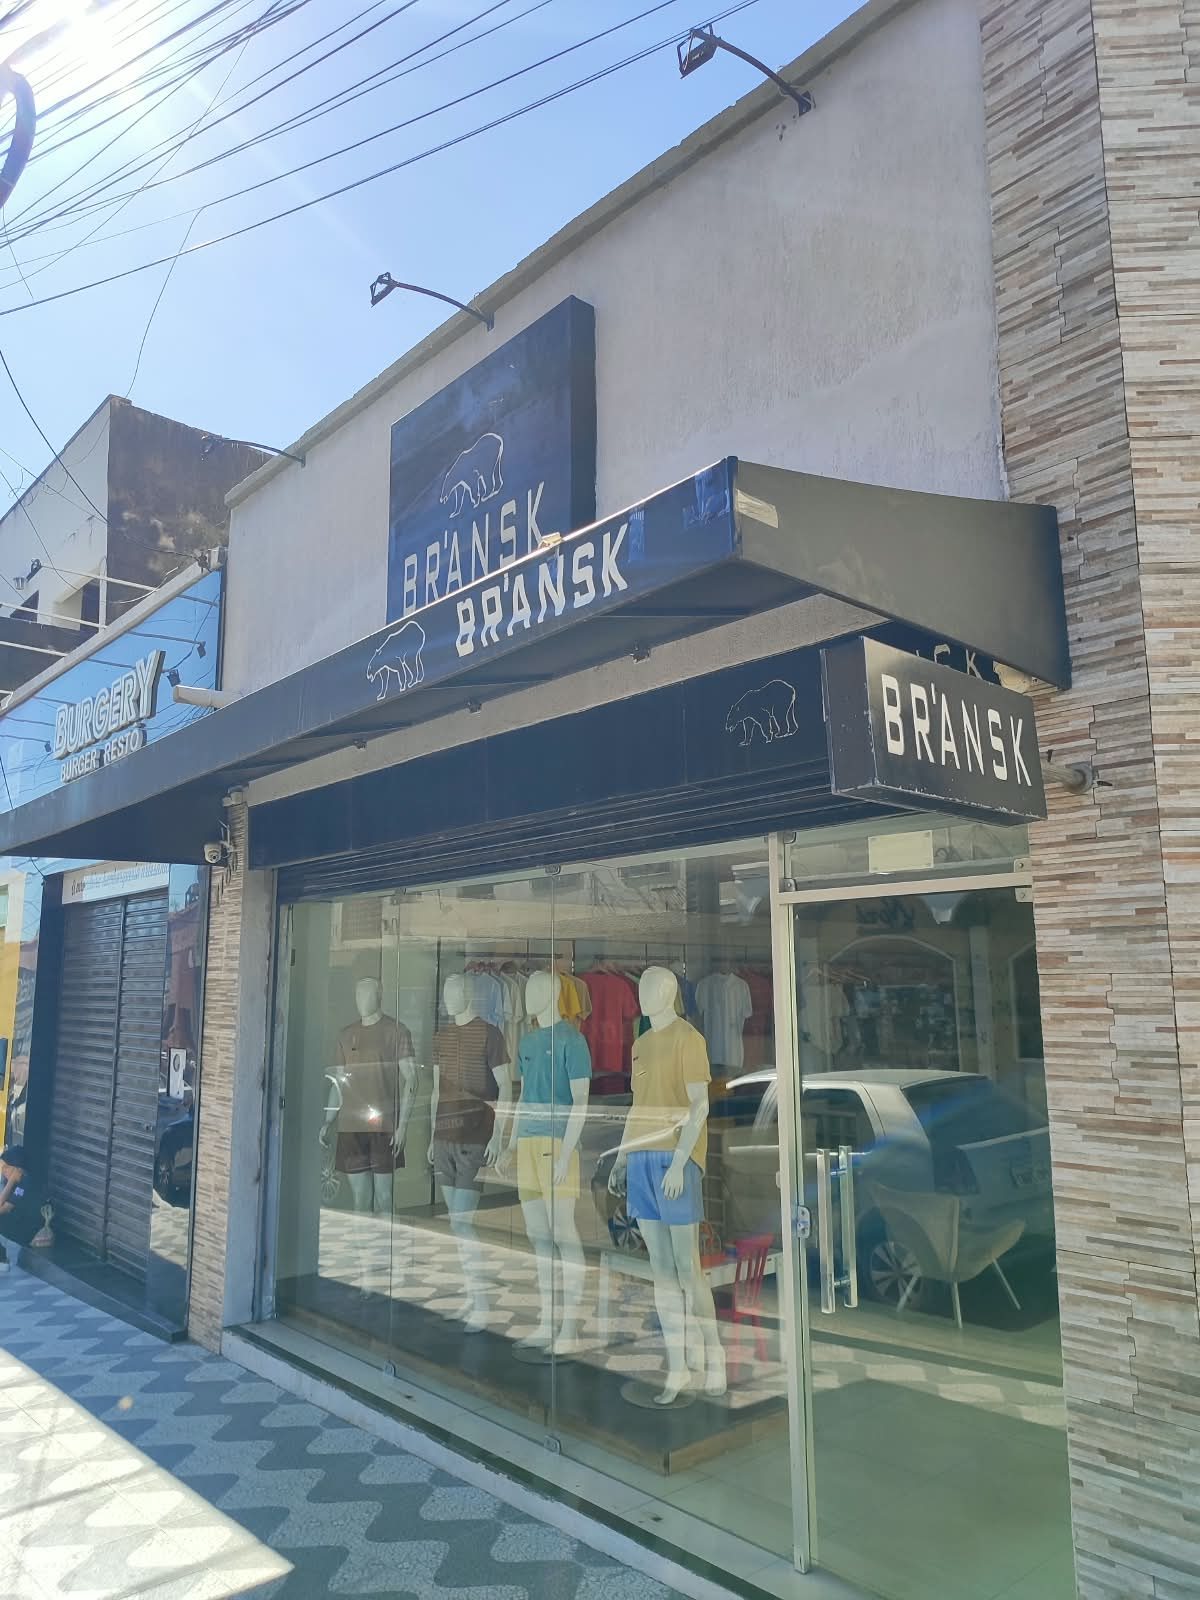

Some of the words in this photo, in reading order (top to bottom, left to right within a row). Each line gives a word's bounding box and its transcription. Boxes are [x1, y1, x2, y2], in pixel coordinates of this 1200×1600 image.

[403, 481, 546, 617] BR'ANSK
[455, 522, 629, 657] BR'ANSK
[53, 649, 166, 760] BURGERY
[881, 673, 1032, 787] BR'ANSK
[60, 748, 100, 784] BURGER
